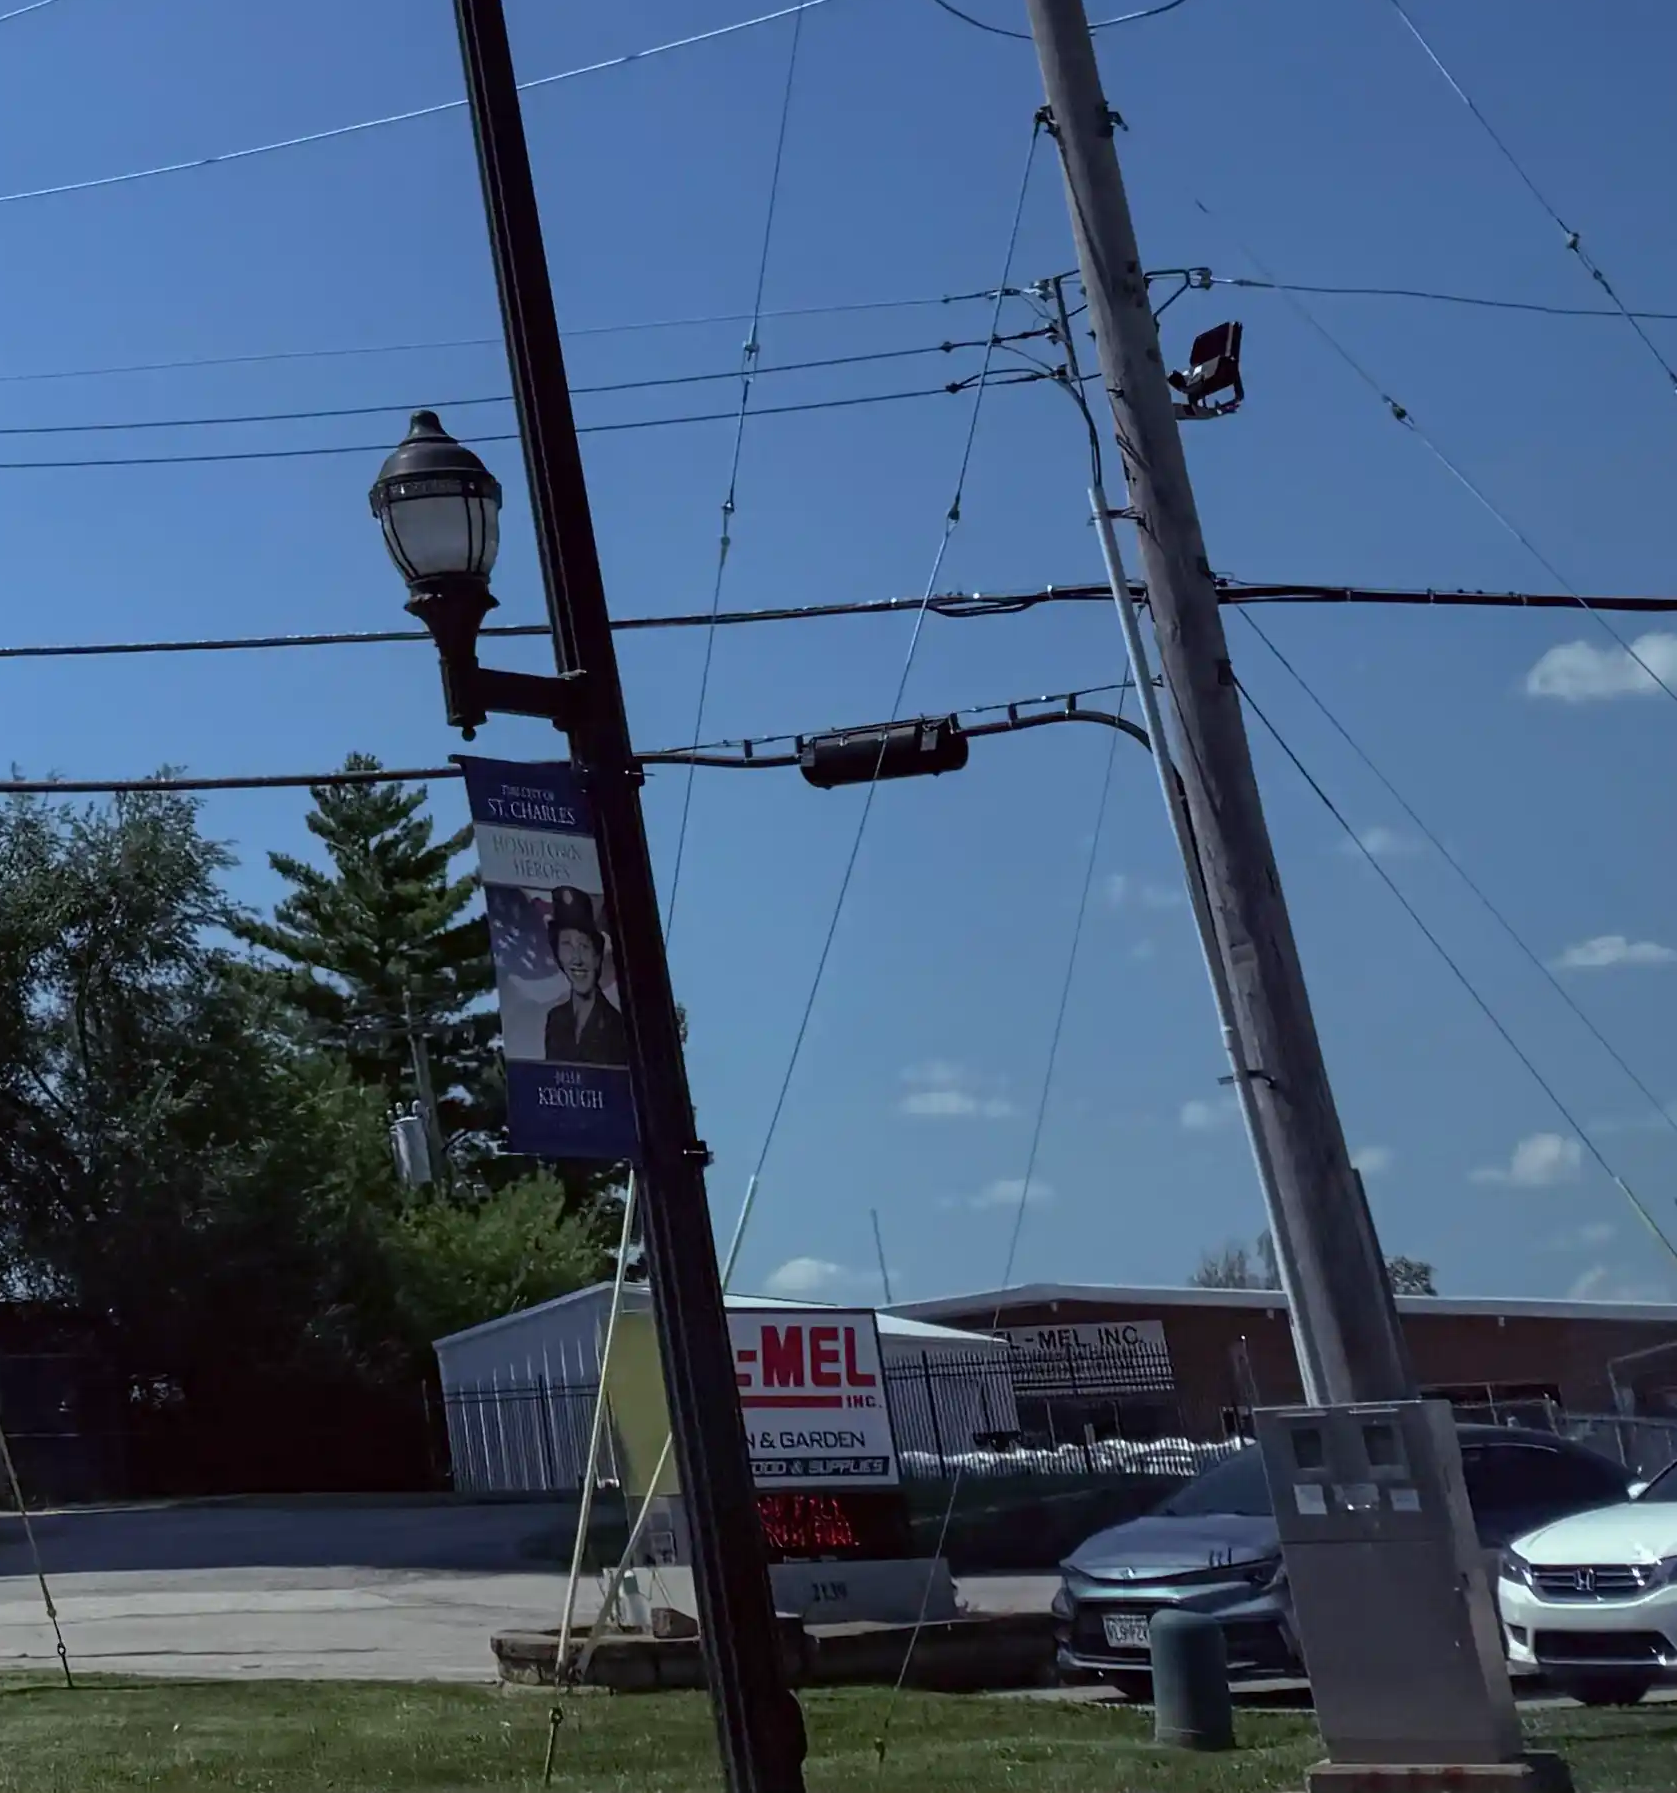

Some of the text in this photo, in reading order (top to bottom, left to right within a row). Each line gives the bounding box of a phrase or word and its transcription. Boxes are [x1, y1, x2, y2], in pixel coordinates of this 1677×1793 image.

[510, 800, 576, 825] CHARLES
[513, 857, 571, 880] HEROES
[538, 1086, 604, 1109] KEOUGH
[1097, 1325, 1146, 1346] INC.
[736, 1325, 877, 1388] -MEL
[846, 1394, 883, 1409] INC.
[760, 1431, 776, 1449] &
[779, 1430, 866, 1450] GARDEN
[808, 1459, 884, 1475] SUPPLIES
